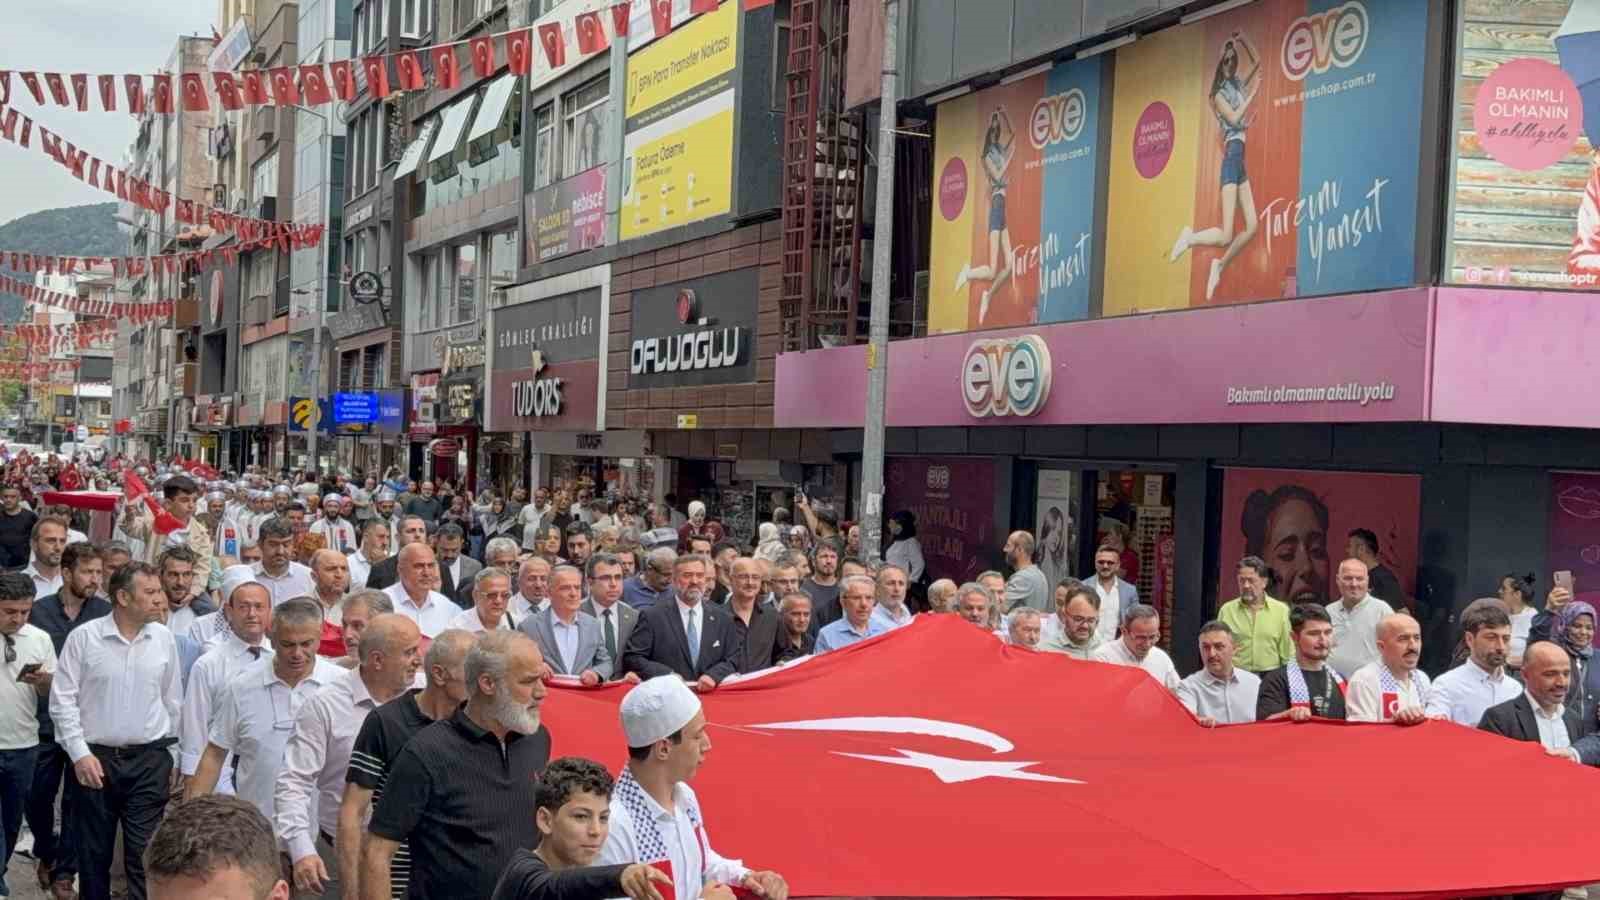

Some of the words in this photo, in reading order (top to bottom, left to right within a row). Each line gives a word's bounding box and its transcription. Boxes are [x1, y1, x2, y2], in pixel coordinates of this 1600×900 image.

[1281, 2, 1368, 81] eve
[1488, 102, 1568, 120] OLMANIN
[1496, 86, 1563, 103] BAKIMLI
[1029, 88, 1086, 149] eve
[630, 316, 740, 375] OFLUOĞLU
[962, 334, 1051, 417] eve
[1360, 381, 1394, 406] yolu
[511, 376, 562, 417] TUDORS
[927, 466, 950, 489] eve
